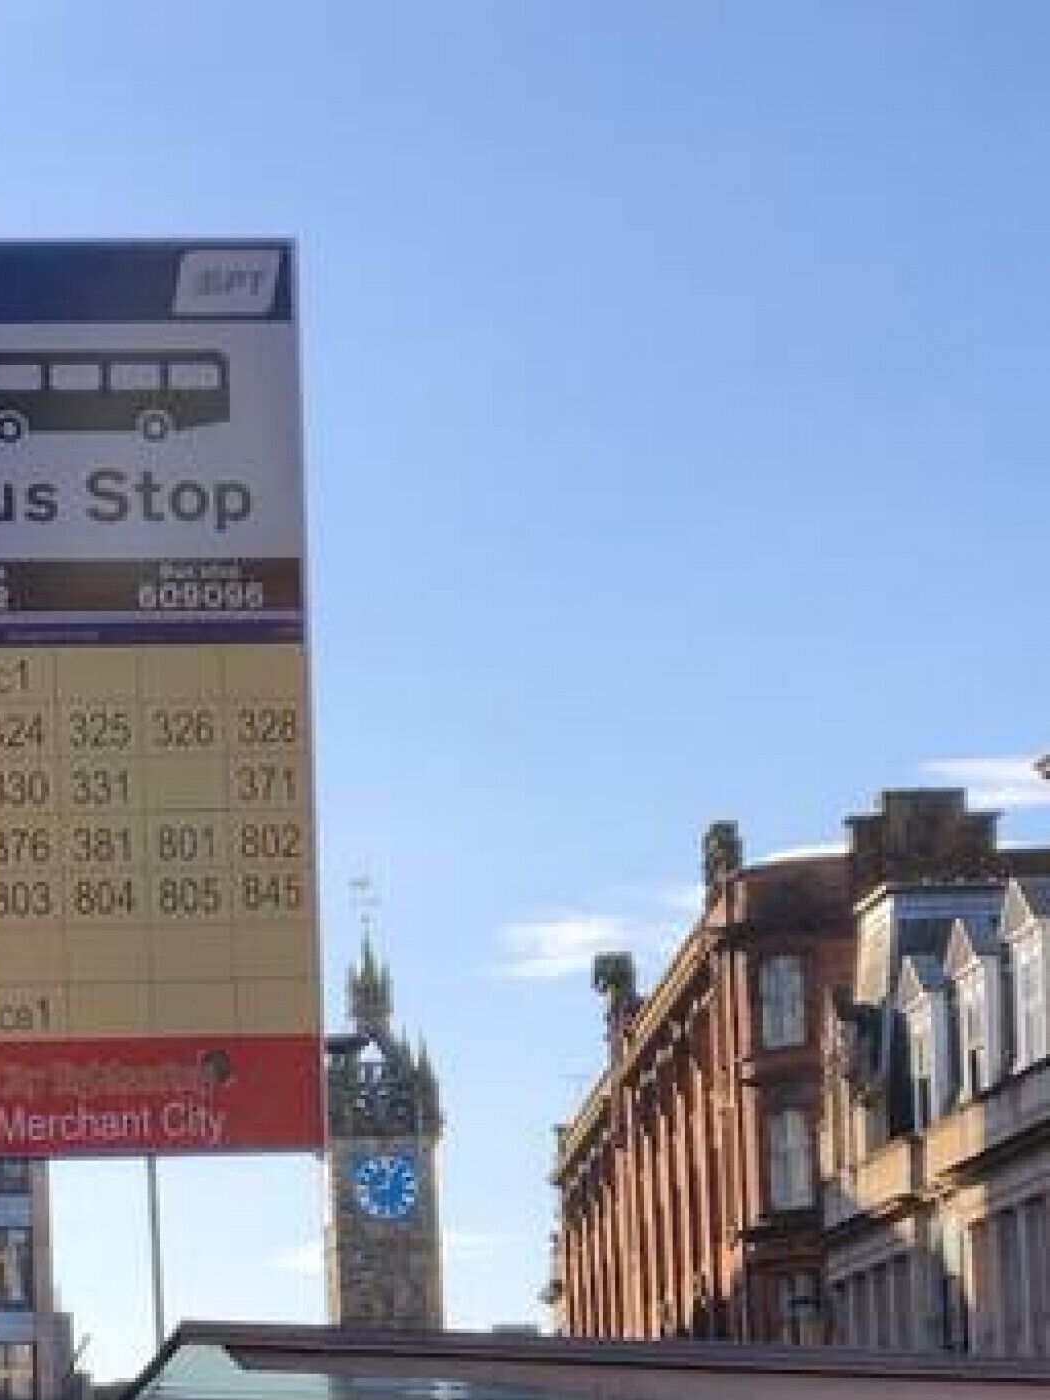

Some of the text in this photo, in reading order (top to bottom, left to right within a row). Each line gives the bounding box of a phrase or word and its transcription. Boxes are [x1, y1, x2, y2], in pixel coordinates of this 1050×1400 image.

[85, 469, 253, 533] Stop
[69, 711, 132, 748] 325
[153, 711, 215, 746] 326
[238, 708, 298, 744] 328
[71, 769, 130, 804] 331
[238, 766, 296, 801] 371
[72, 828, 132, 863] 381
[158, 825, 217, 860] 801
[240, 823, 303, 859] 802
[74, 879, 134, 915] 804
[158, 877, 222, 913] 805
[243, 875, 303, 911] 845
[162, 1099, 227, 1147] City
